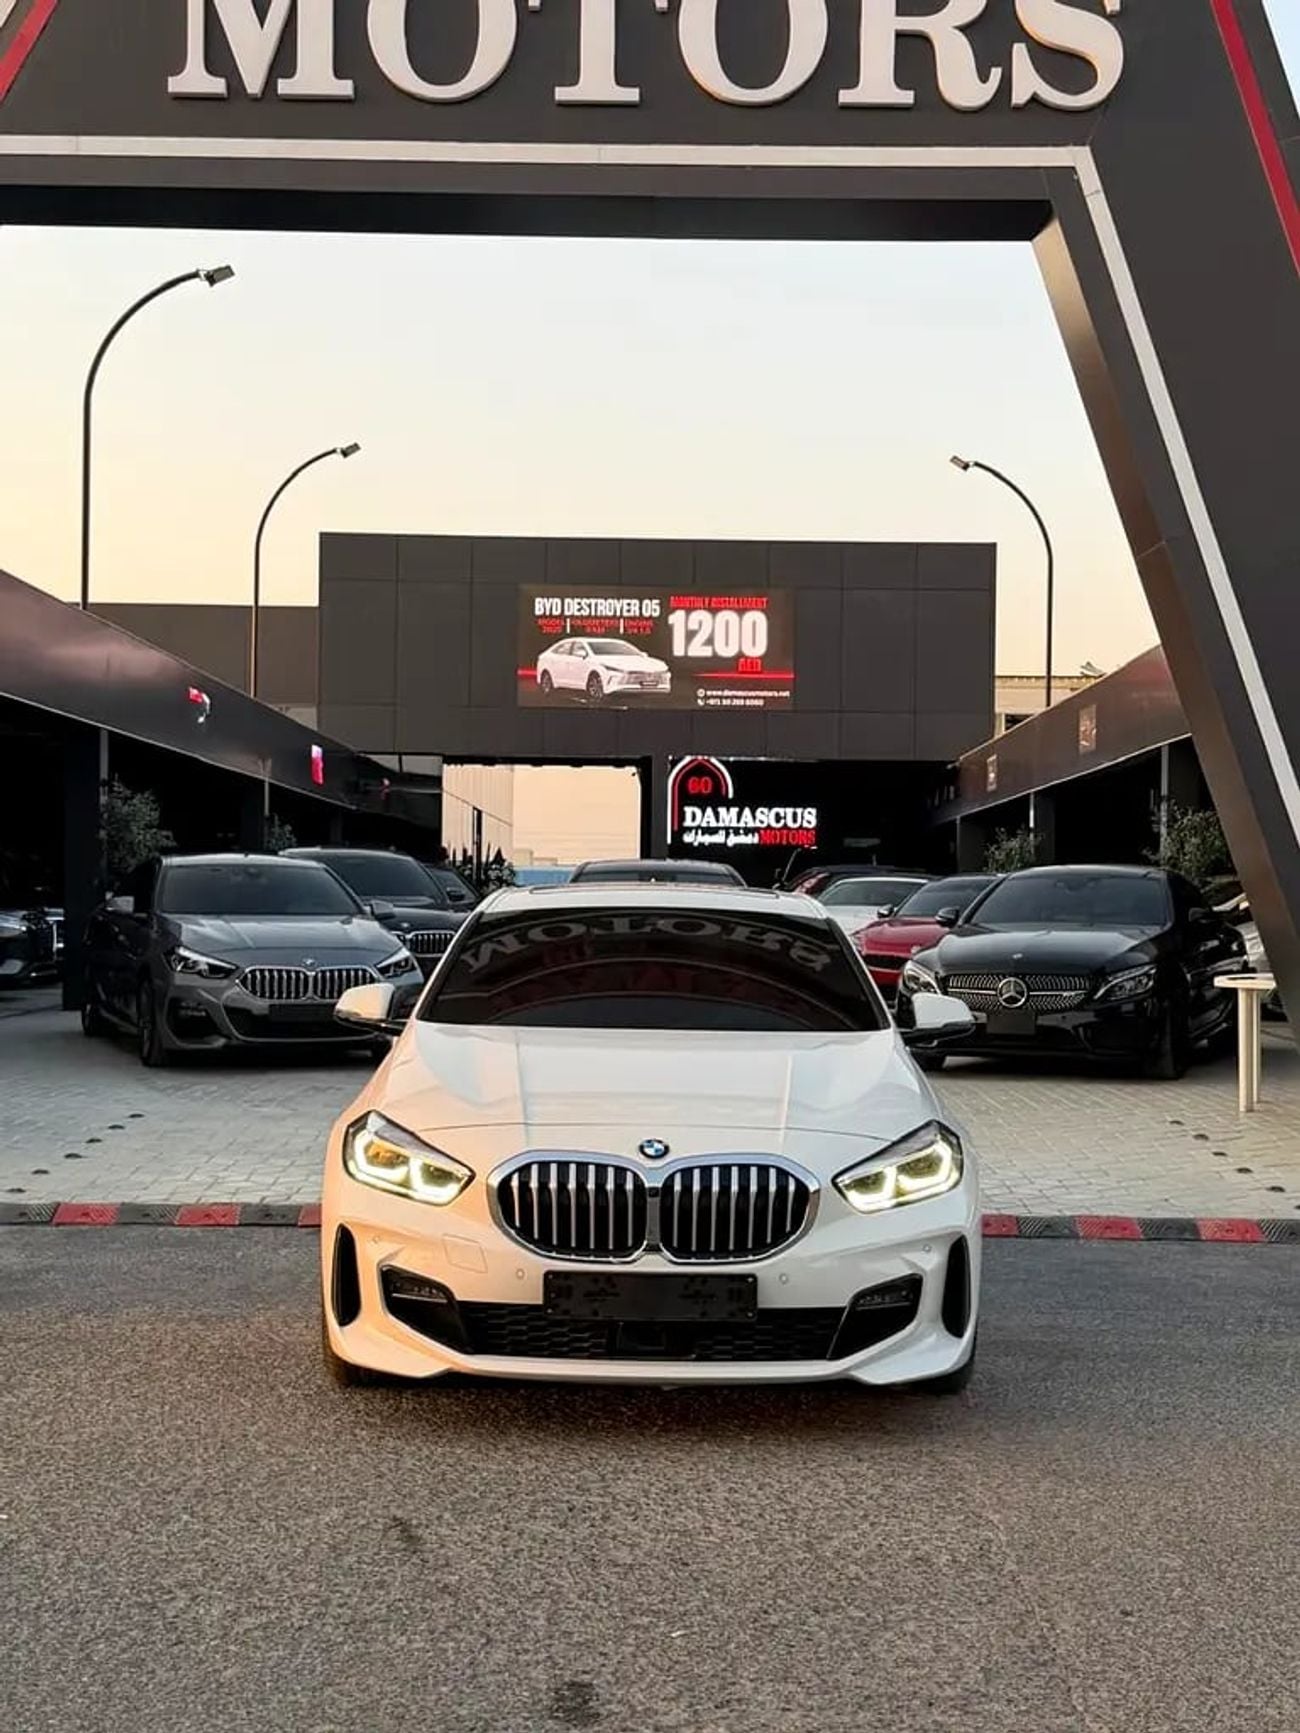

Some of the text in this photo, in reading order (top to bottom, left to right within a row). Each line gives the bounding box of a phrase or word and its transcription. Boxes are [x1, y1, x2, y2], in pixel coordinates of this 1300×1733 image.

[167, 0, 1126, 111] MOTORS
[534, 597, 661, 617] BYD DESTROYER 05
[667, 609, 768, 658] 1200
[682, 805, 818, 828] DAMASCUS
[759, 829, 816, 845] MOTORS
